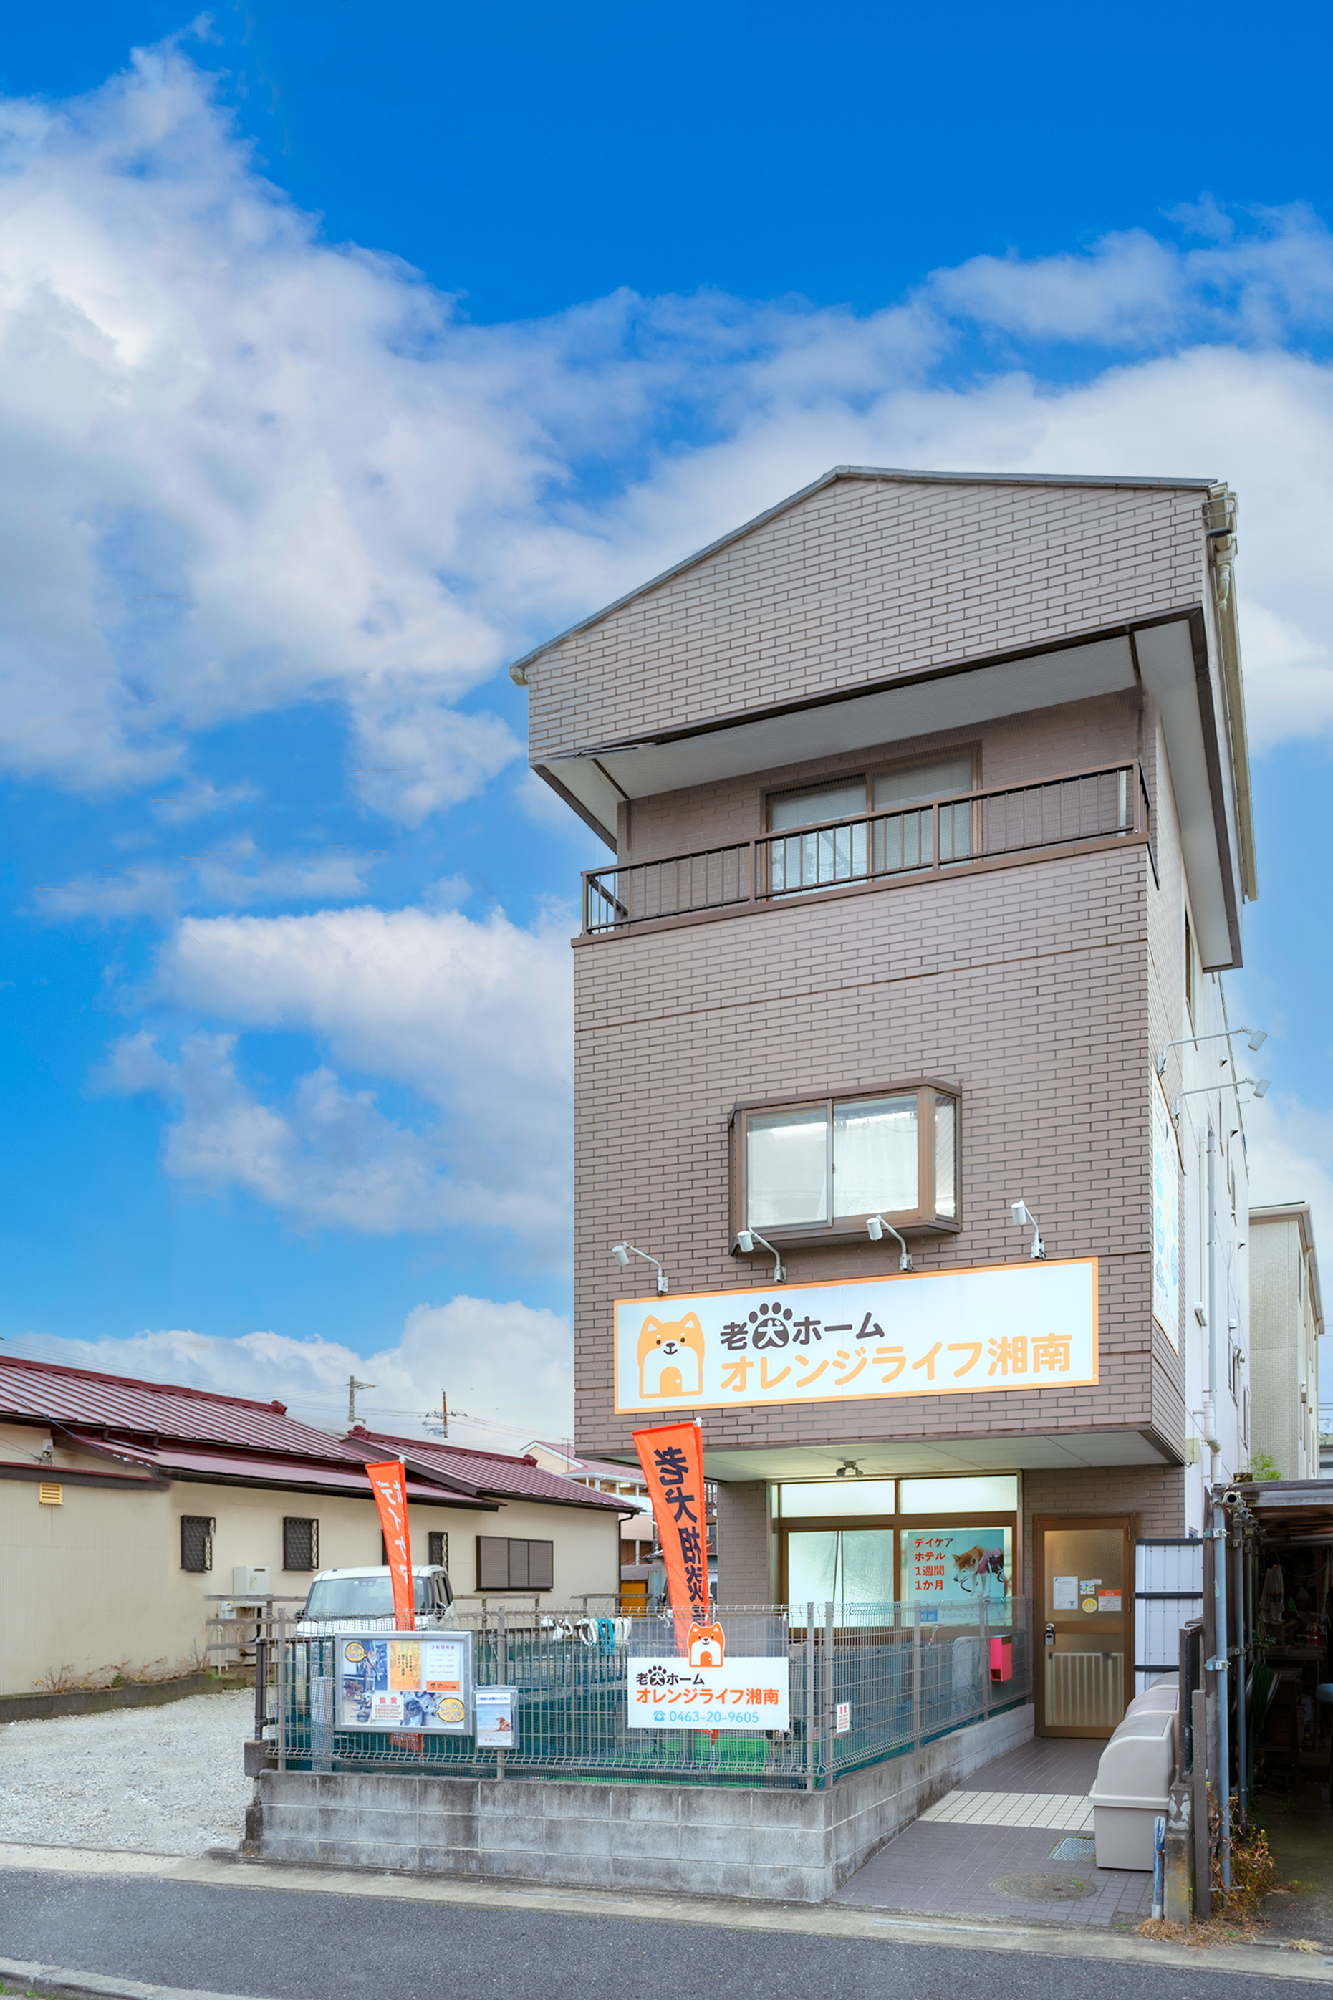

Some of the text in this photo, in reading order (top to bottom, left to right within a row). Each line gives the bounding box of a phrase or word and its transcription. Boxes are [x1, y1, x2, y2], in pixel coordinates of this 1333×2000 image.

[720, 1311, 886, 1351] 老犬ホーム
[720, 1332, 1073, 1392] オレンジライフ湘南
[914, 1537, 954, 1548] デイケア
[914, 1551, 946, 1562] ホテル
[914, 1565, 945, 1577] 1週間
[914, 1580, 944, 1591] 1か月
[636, 1672, 705, 1686] 老犬ホーム
[636, 1687, 780, 1705] オレンジライフ湘南
[669, 1711, 760, 1723] 0463-20-9605
